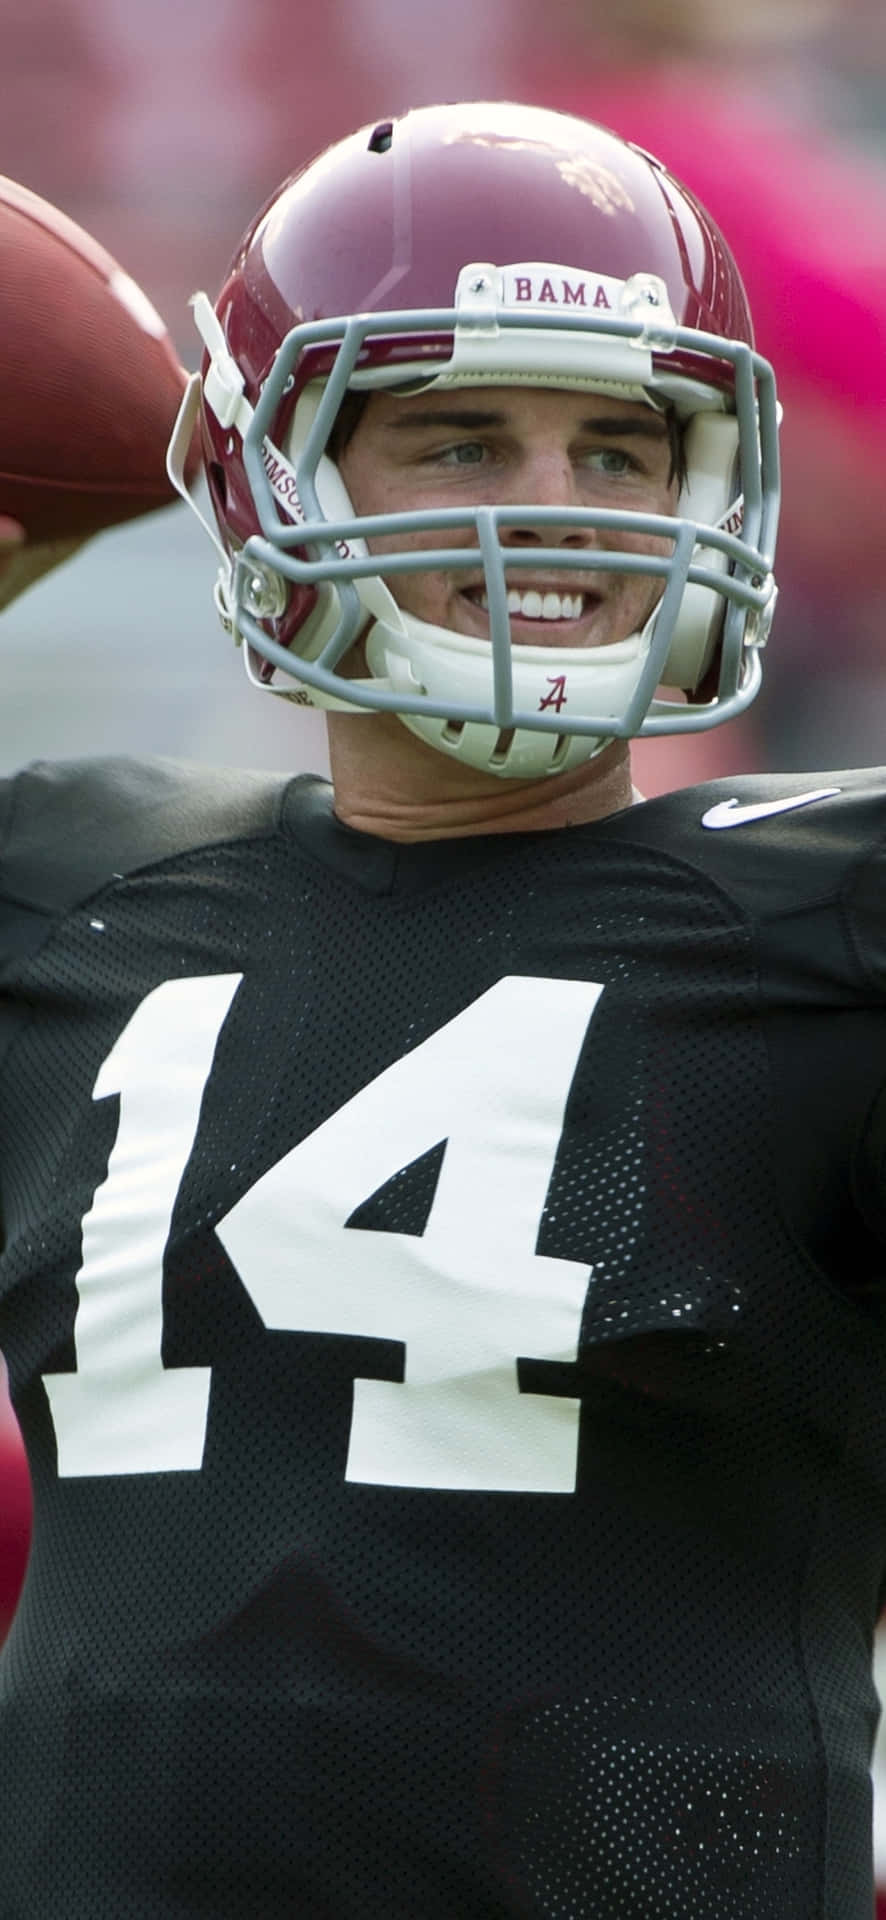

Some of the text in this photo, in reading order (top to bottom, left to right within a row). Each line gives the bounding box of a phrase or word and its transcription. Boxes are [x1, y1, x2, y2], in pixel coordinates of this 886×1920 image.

[515, 277, 612, 309] BAMA
[262, 446, 307, 522] IMSO
[537, 675, 567, 713] A
[42, 972, 605, 1493] 14
